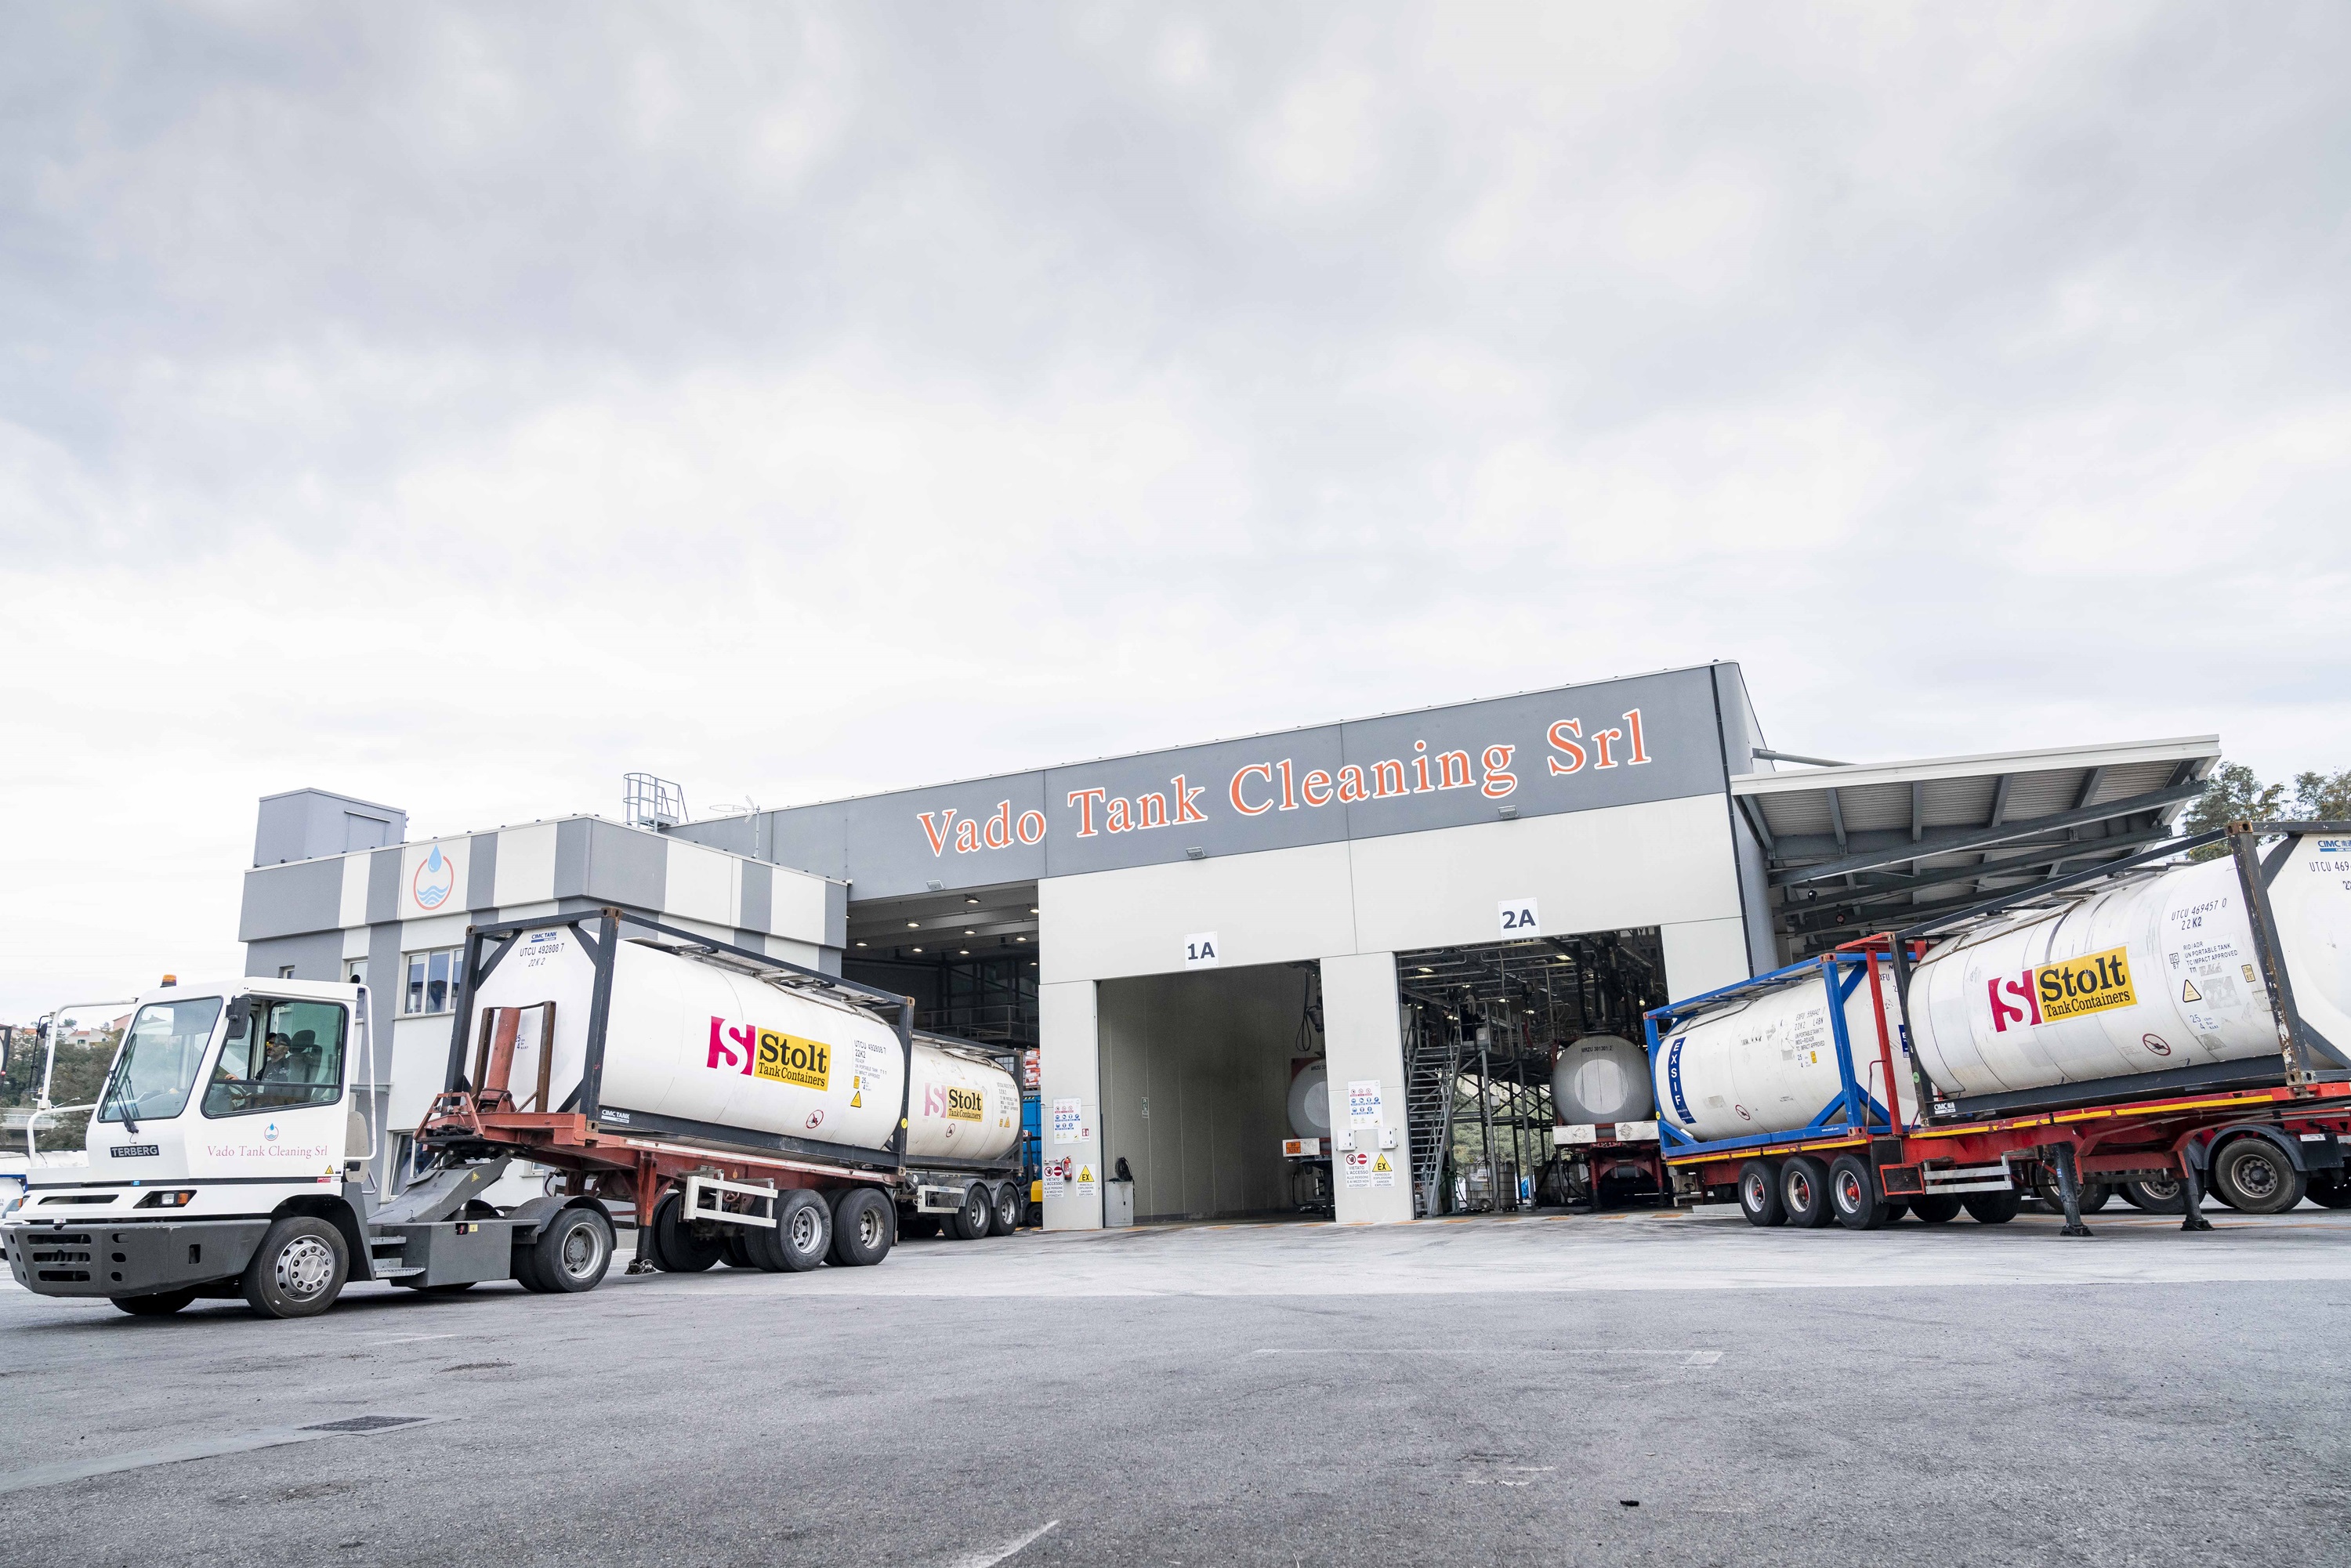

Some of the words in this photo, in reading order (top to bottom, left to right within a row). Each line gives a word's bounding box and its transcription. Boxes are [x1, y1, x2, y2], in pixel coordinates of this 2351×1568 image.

[917, 799, 1047, 856] Vado
[1067, 774, 1208, 838] Tank
[1230, 740, 1519, 816] Cleaning
[1546, 708, 1651, 776] Srl
[2309, 861, 2331, 872] UTCU
[2335, 861, 2351, 871] 469
[2171, 907, 2189, 921] UTCU
[2191, 900, 2219, 915] 469457
[1502, 909, 1537, 929] 2A
[520, 947, 537, 957] UTCU
[538, 943, 560, 954] 492808
[1187, 942, 1215, 960] 1A
[2192, 946, 2218, 956] PORTABLE
[2193, 955, 2211, 965] IMPACT
[2212, 950, 2238, 961] APPROVED
[2039, 954, 2126, 1003] Stolt
[2190, 1014, 2201, 1023] 25
[759, 1034, 827, 1074] Stolt
[1670, 1041, 1681, 1106] EXSIF
[948, 1088, 982, 1111] Stolt
[111, 1145, 158, 1157] TERBERG
[207, 1145, 235, 1157] Vado
[238, 1145, 265, 1157] Tank
[268, 1145, 312, 1160] Cleaning
[314, 1145, 328, 1157] Srl
[1377, 1162, 1386, 1171] EX
